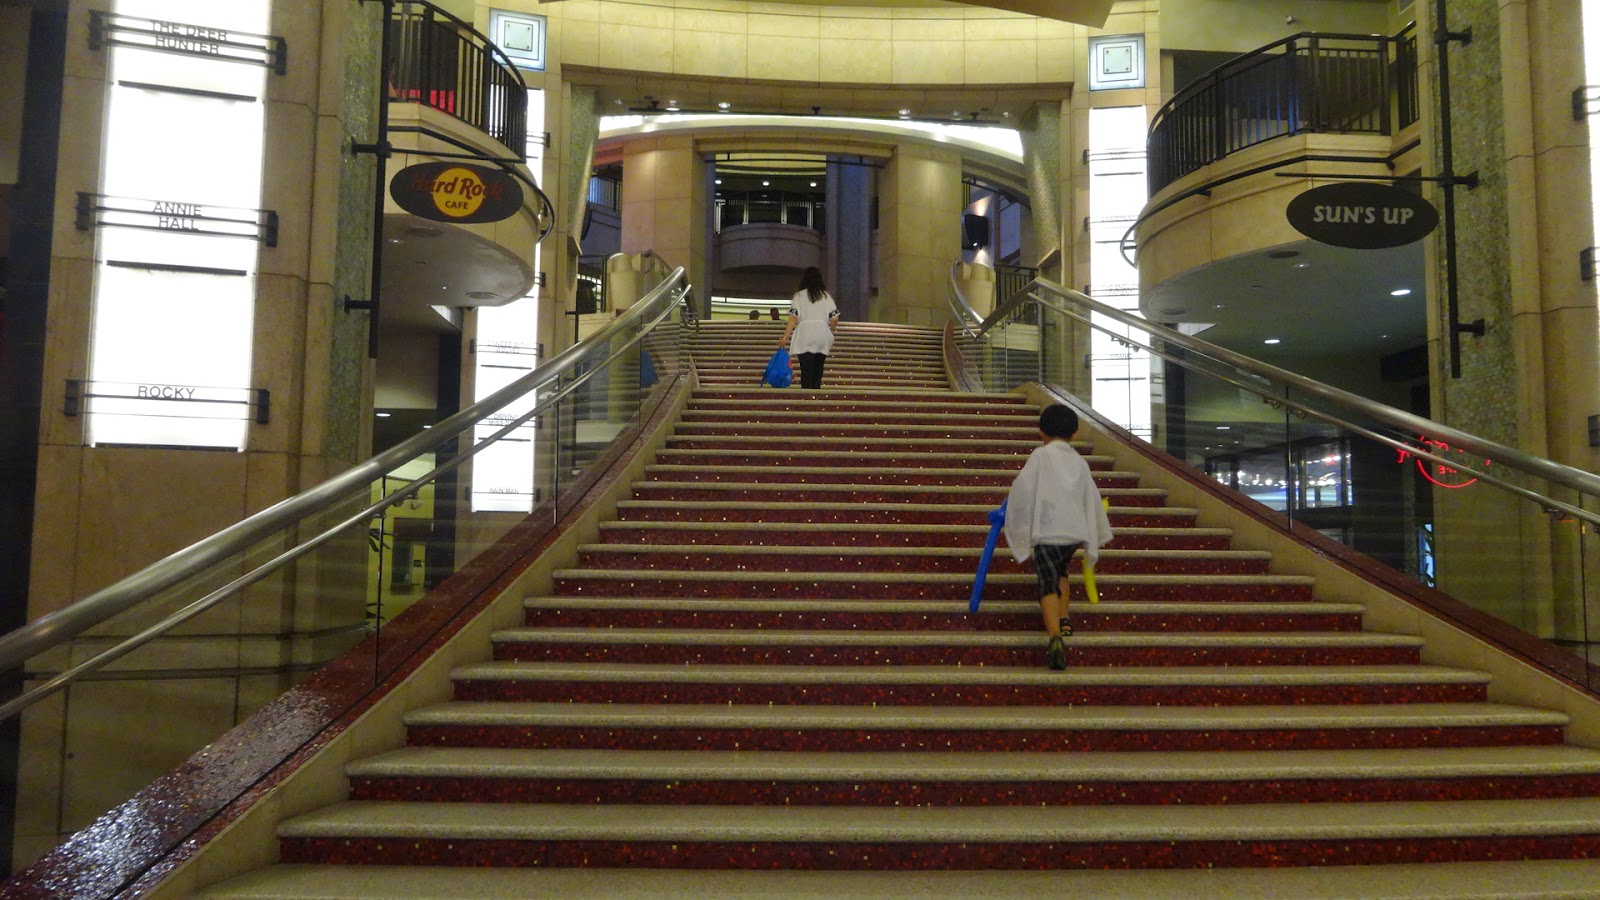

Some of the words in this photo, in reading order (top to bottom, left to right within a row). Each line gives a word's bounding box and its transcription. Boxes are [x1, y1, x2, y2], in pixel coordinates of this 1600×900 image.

[152, 20, 180, 34] THE
[186, 25, 227, 41] DEER
[156, 35, 219, 54] HUNTER
[411, 172, 459, 194] Hard
[460, 177, 505, 200] Rock
[153, 201, 202, 217] ANNIE
[445, 201, 468, 210] CAFE
[159, 216, 199, 231] HALL
[1313, 205, 1376, 224] SUN'S
[1383, 207, 1414, 225] UP
[138, 385, 195, 400] ROCKY
